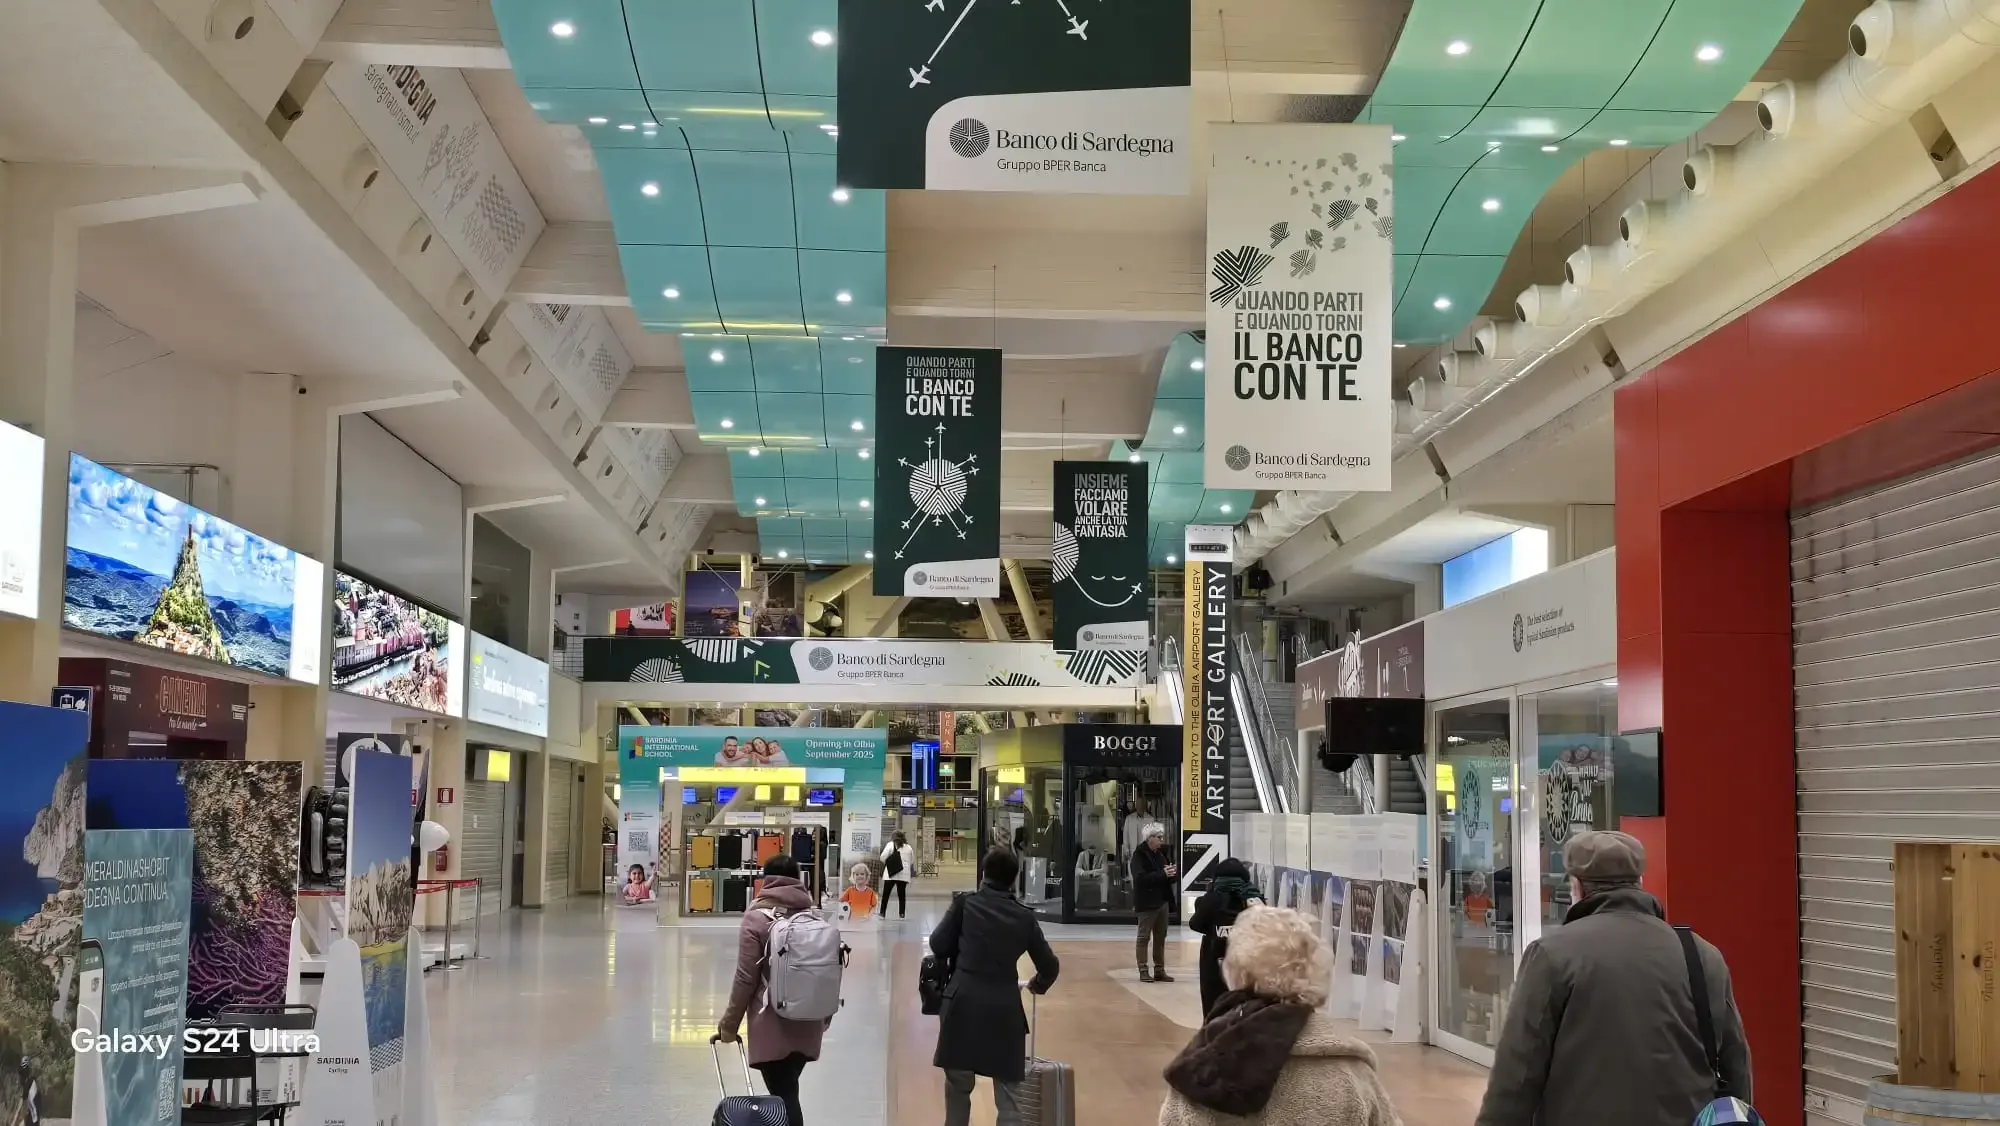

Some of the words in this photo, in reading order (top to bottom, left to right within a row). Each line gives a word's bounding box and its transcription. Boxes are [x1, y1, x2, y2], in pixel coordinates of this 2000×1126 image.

[996, 129, 1057, 150] Banco
[1061, 131, 1077, 151] di
[1082, 131, 1174, 157] Sardegna
[997, 158, 1041, 173] Gruppo
[1043, 159, 1071, 171] BPER
[1073, 160, 1107, 172] Banca
[1235, 290, 1309, 311] QUANDO
[1313, 292, 1363, 312] PARTI
[1234, 312, 1244, 330] E
[1247, 312, 1313, 331] QUANDO
[1316, 313, 1363, 332] TORNI
[1234, 331, 1259, 361] IL
[1266, 332, 1363, 363] BANCO
[906, 356, 946, 368] QUANDO
[948, 357, 975, 369] PARTI
[906, 367, 912, 377] E
[913, 368, 948, 378] QUANDO
[949, 368, 975, 379] TORNI
[1234, 362, 1307, 401] CON
[1315, 363, 1362, 401] TE.
[905, 377, 920, 395] IL
[923, 378, 975, 396] BANCO
[905, 394, 946, 417] CON
[949, 395, 975, 417] TE.
[1254, 452, 1295, 466] Banco
[1296, 452, 1308, 466] di
[1310, 452, 1371, 468] Sardegna
[1074, 473, 1129, 489] INSIEME
[1255, 470, 1284, 480] Gruppo
[1284, 471, 1303, 479] BPER
[1304, 471, 1326, 480] Banca
[1074, 488, 1128, 501] FACCIAMO
[1074, 500, 1128, 517] VOLARE
[1075, 515, 1101, 526] ANCHE
[1101, 515, 1112, 526] LA
[1112, 516, 1128, 526] TUA
[1192, 568, 1201, 619] GALLERY
[1207, 567, 1226, 683] GALLERY
[1192, 620, 1200, 671] AIRPORT
[837, 652, 874, 666] Banco
[876, 652, 887, 666] di
[889, 652, 945, 668] Sardegna
[1191, 673, 1200, 708] OLBIA
[1191, 711, 1199, 731] THE
[805, 739, 841, 749] Opening
[843, 740, 852, 748] in
[853, 740, 876, 748] Olbia
[1094, 735, 1158, 750] BOGGI
[1191, 733, 1199, 749] TO
[805, 750, 851, 759] September
[852, 750, 874, 759] 2025
[1190, 751, 1200, 788] ENTRY
[1190, 791, 1199, 819] FREE
[84, 857, 170, 881] MERALDINASHOP.IT
[123, 881, 169, 905] CONTINUA
[316, 1057, 360, 1065] SARDINIA
